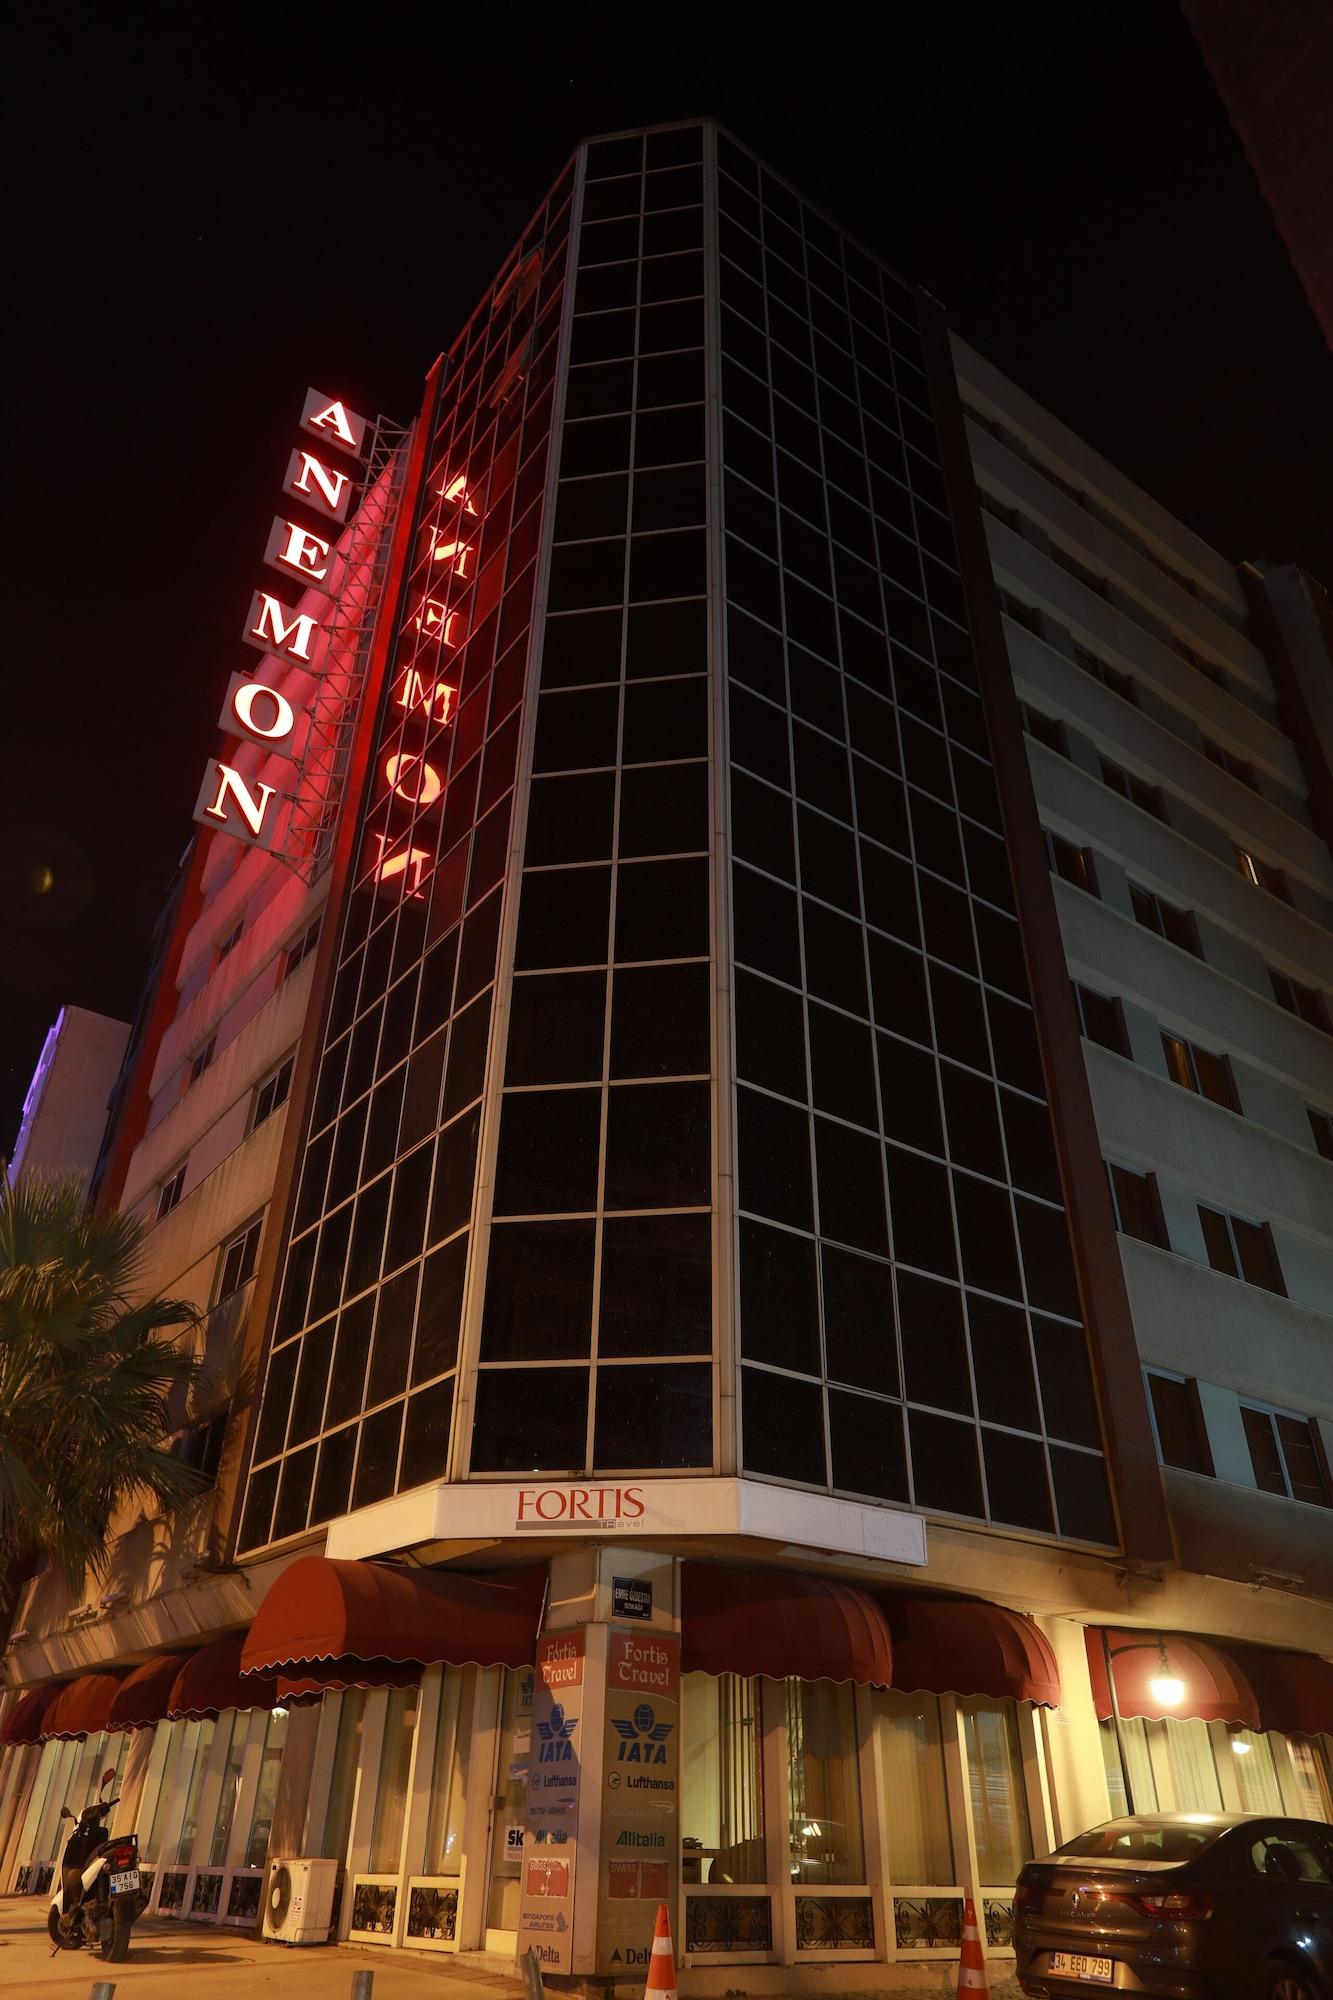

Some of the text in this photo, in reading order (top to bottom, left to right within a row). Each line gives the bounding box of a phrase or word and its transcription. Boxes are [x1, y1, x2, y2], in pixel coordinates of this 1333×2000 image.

[206, 401, 357, 835] ANEMON
[517, 1488, 645, 1520] FORTIS
[547, 1641, 577, 1663] Fortis
[623, 1641, 669, 1665] Fortis
[542, 1661, 577, 1683] Travel
[618, 1662, 669, 1686] Travel
[539, 1740, 572, 1762] IATA
[618, 1741, 667, 1764] IATA
[544, 1775, 577, 1788] Lufthansa
[627, 1775, 674, 1790] Lufthansa
[616, 1830, 665, 1847] Alitalia
[610, 1863, 637, 1872] SWISS
[111, 1875, 121, 1884] 35
[536, 1945, 560, 1963] Delta
[1056, 1954, 1066, 1969] 34
[1092, 1959, 1110, 1976] 799
